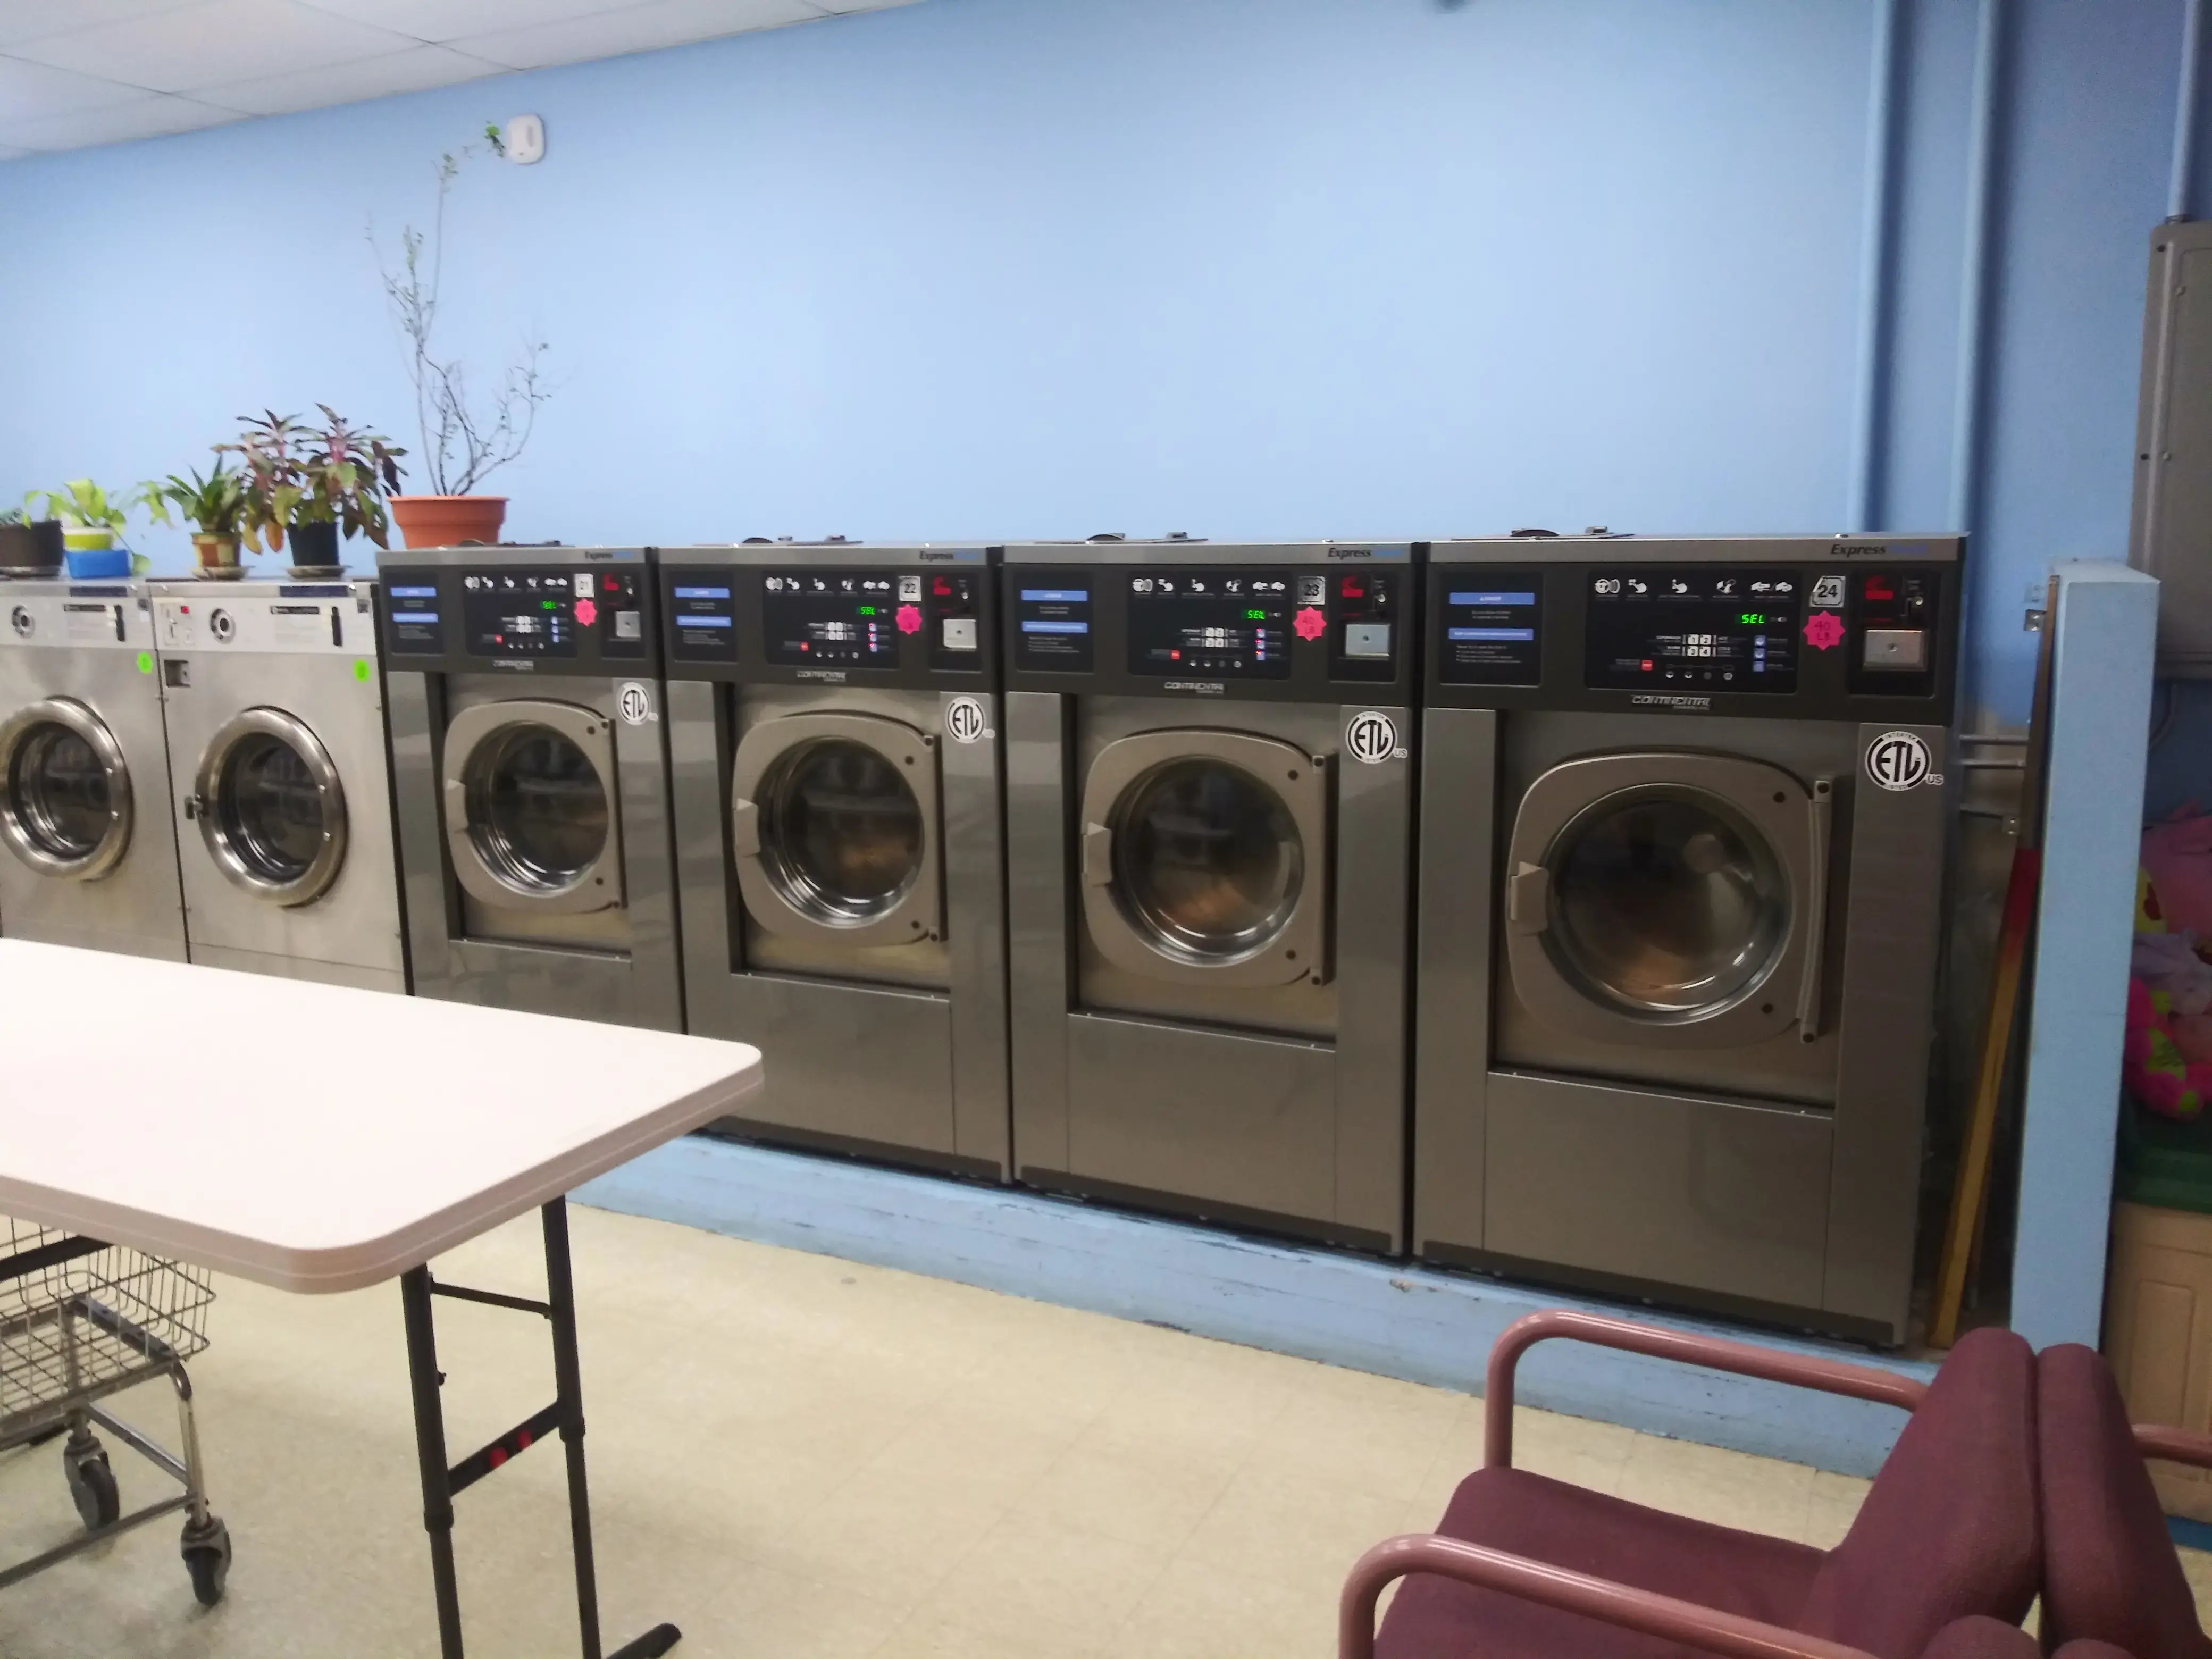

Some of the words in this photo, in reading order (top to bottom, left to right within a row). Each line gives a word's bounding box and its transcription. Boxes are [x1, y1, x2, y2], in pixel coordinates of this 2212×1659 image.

[1328, 548, 1371, 559] Express
[1830, 544, 1887, 557] Express
[1304, 584, 1320, 596] 23
[1817, 585, 1838, 598] 24
[1247, 610, 1266, 619] SEL
[1741, 614, 1765, 624] SEL
[1814, 621, 1831, 630] 40
[952, 705, 979, 736] ETL
[1354, 720, 1388, 755] ETL
[1876, 741, 1921, 782] ETL
[1928, 775, 1943, 784] US
